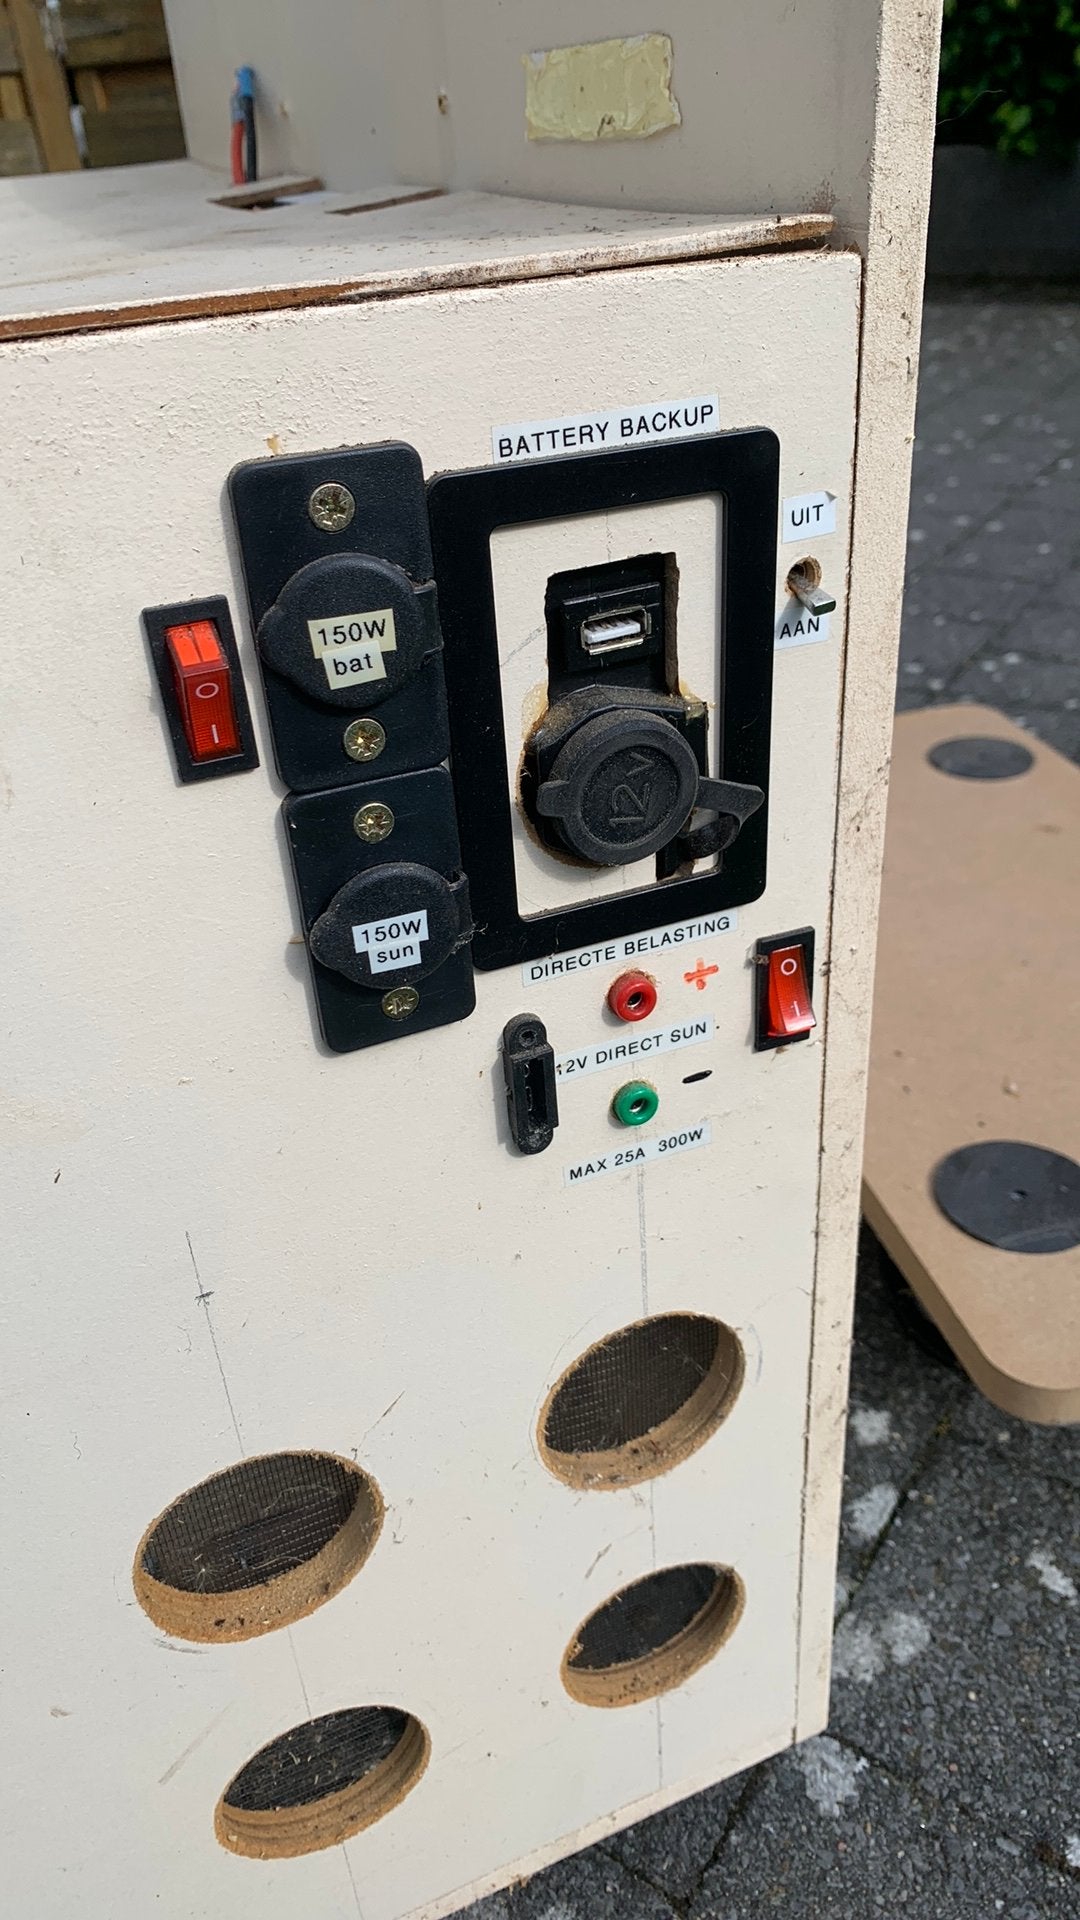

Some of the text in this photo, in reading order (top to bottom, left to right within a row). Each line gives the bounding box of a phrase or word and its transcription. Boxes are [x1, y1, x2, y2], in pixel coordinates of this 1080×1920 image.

[498, 404, 714, 458] BATTERY BACKUP
[791, 504, 824, 526] UIT
[318, 618, 386, 646] 150W
[779, 617, 820, 640] AAN
[333, 652, 374, 676] bat
[609, 751, 654, 826] 12V
[361, 918, 421, 944] 150W
[376, 944, 414, 964] sun
[530, 916, 730, 980] DIRECTE BELASTING
[556, 1021, 707, 1075] 12V DIRECT SUN
[569, 1128, 704, 1180] MAX 25A 300W
